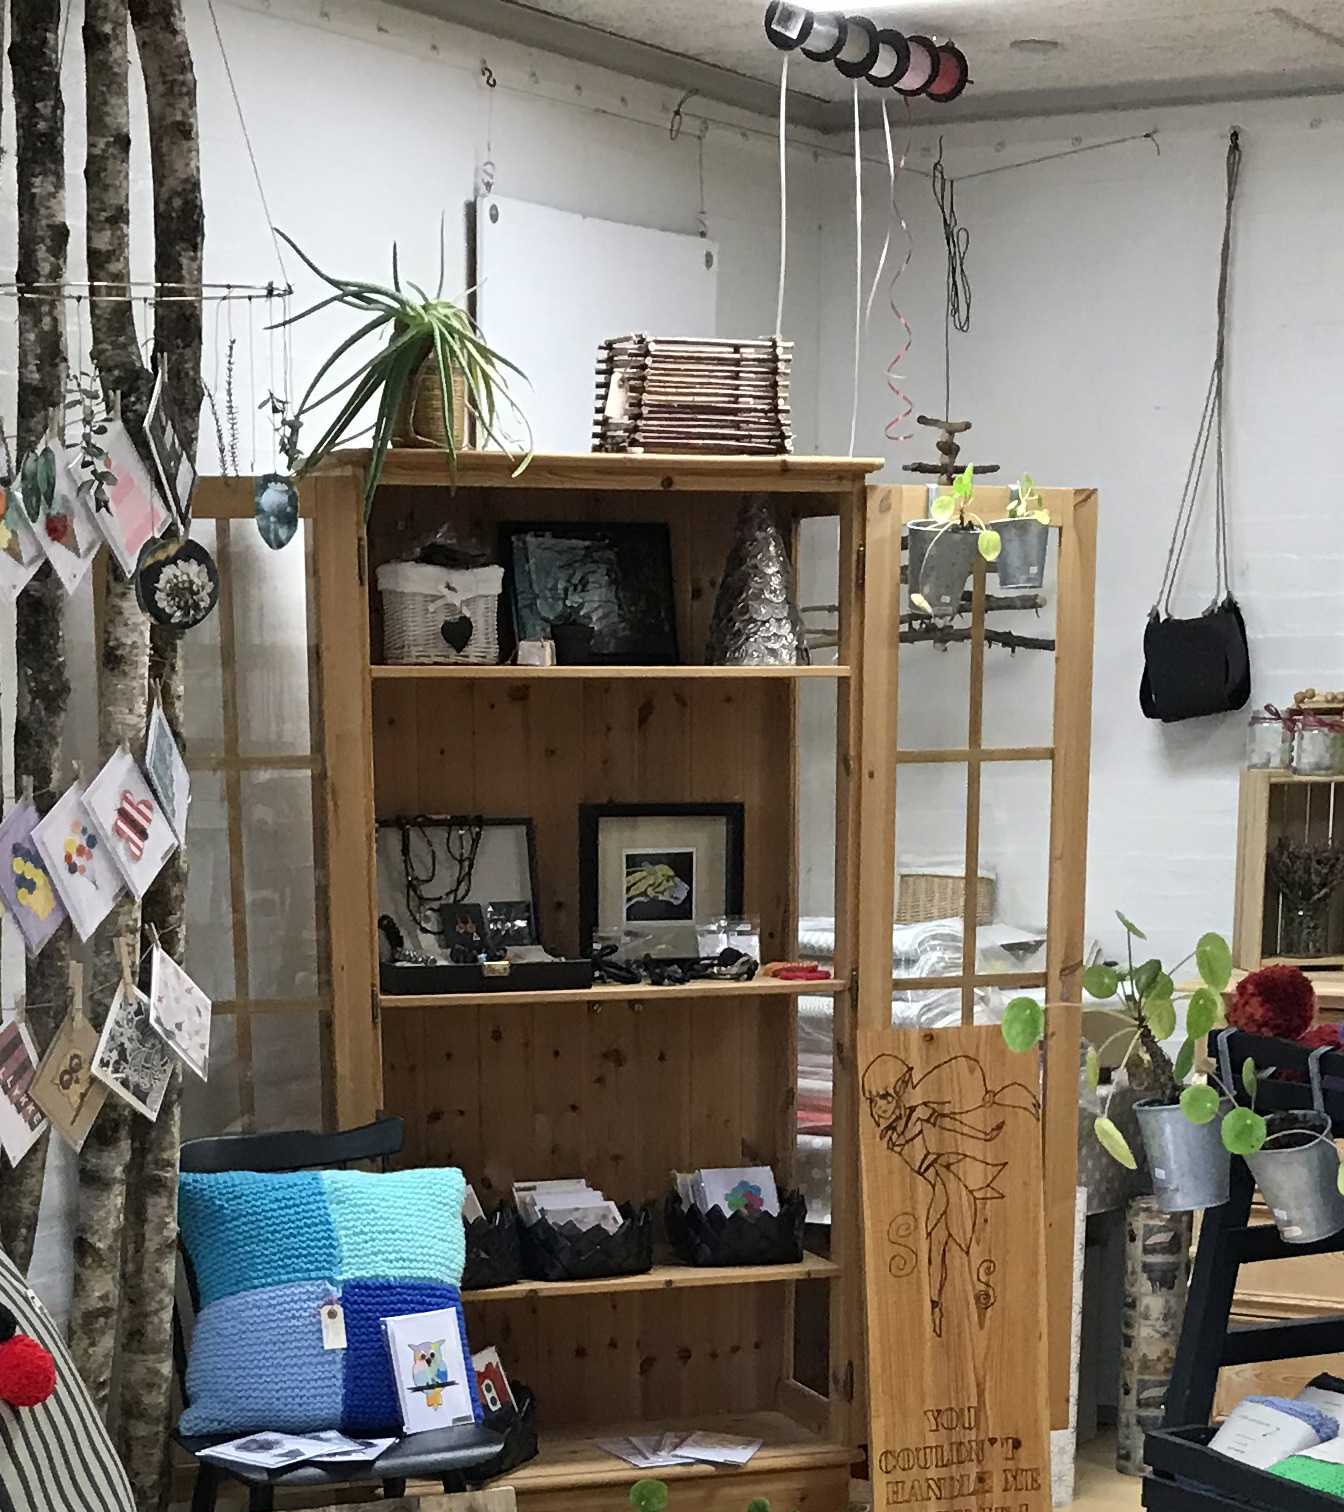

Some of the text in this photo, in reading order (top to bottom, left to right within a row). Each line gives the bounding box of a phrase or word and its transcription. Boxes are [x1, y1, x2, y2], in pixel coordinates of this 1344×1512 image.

[923, 1405, 977, 1432] YOU
[885, 1467, 1042, 1506] HANDLE ME
